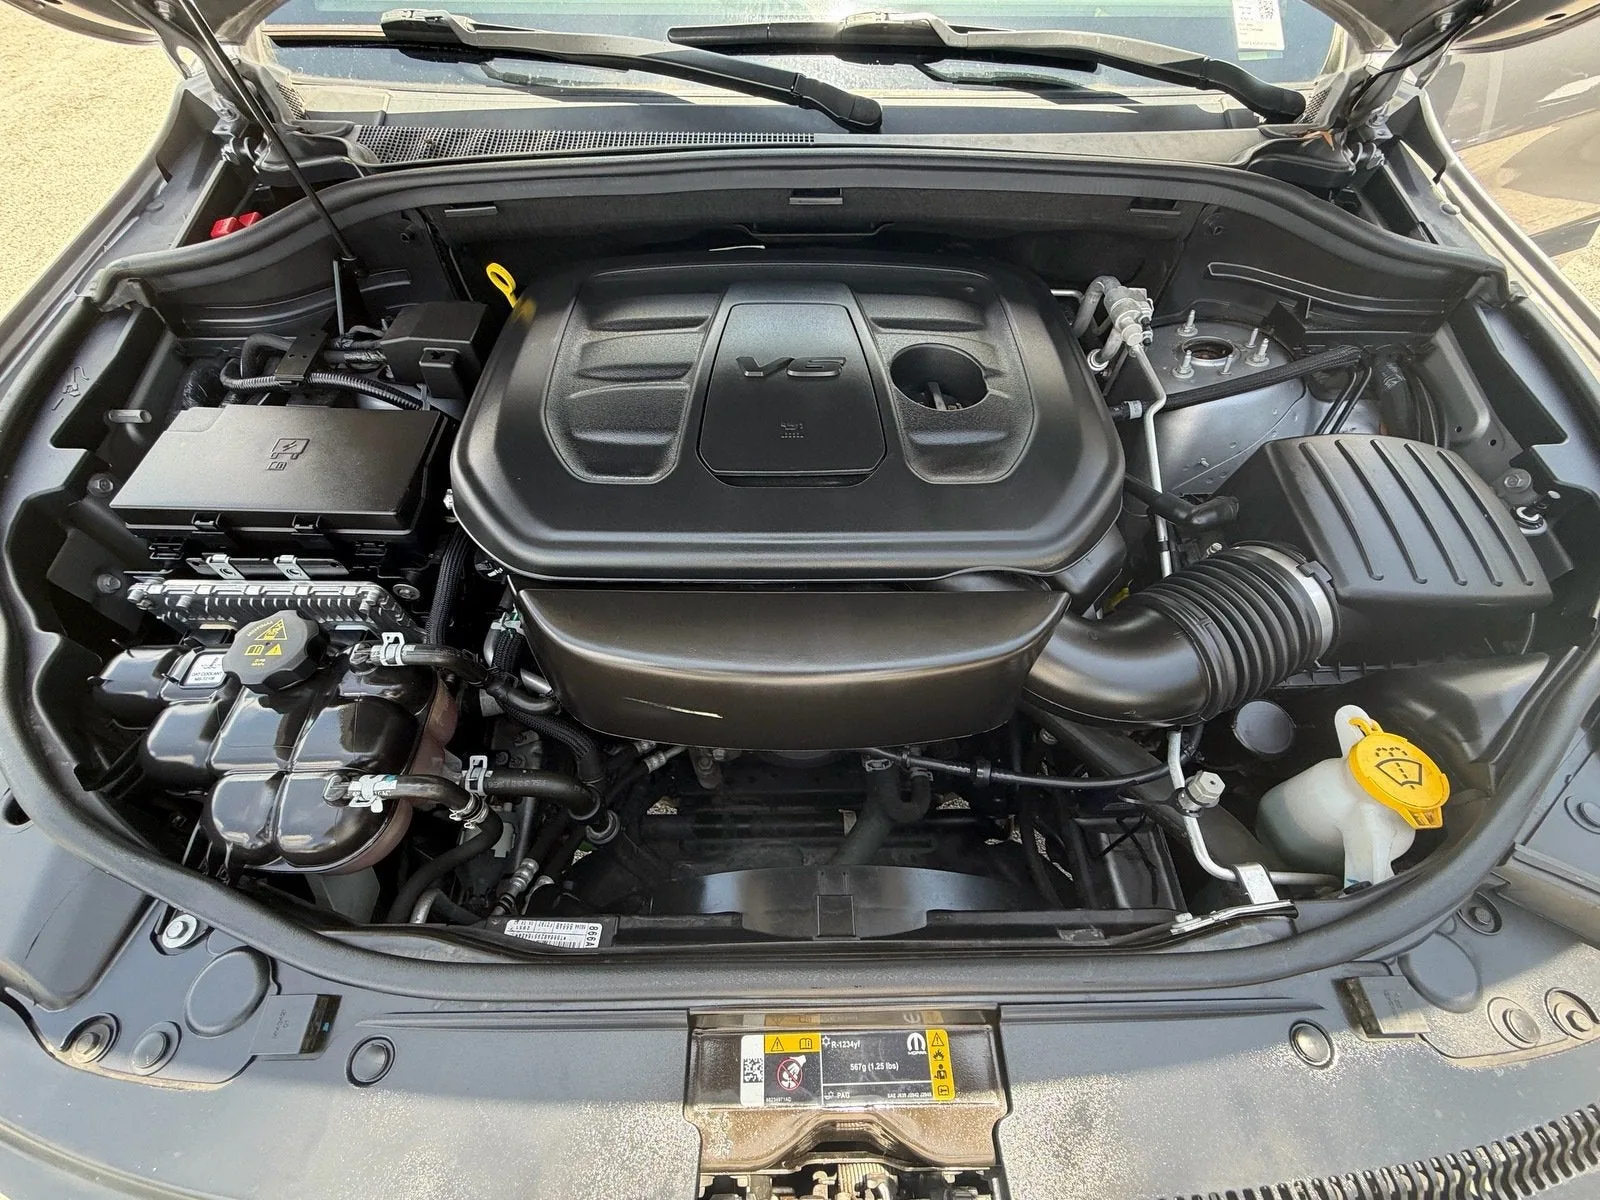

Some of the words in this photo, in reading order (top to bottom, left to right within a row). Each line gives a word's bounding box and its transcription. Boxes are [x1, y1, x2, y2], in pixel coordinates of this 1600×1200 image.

[735, 356, 846, 378] V6
[586, 926, 599, 947] 866A
[831, 1040, 861, 1050] R-1234yf
[850, 1063, 867, 1073] 567g
[867, 1062, 885, 1072] (1.25
[885, 1061, 899, 1072] lbs)
